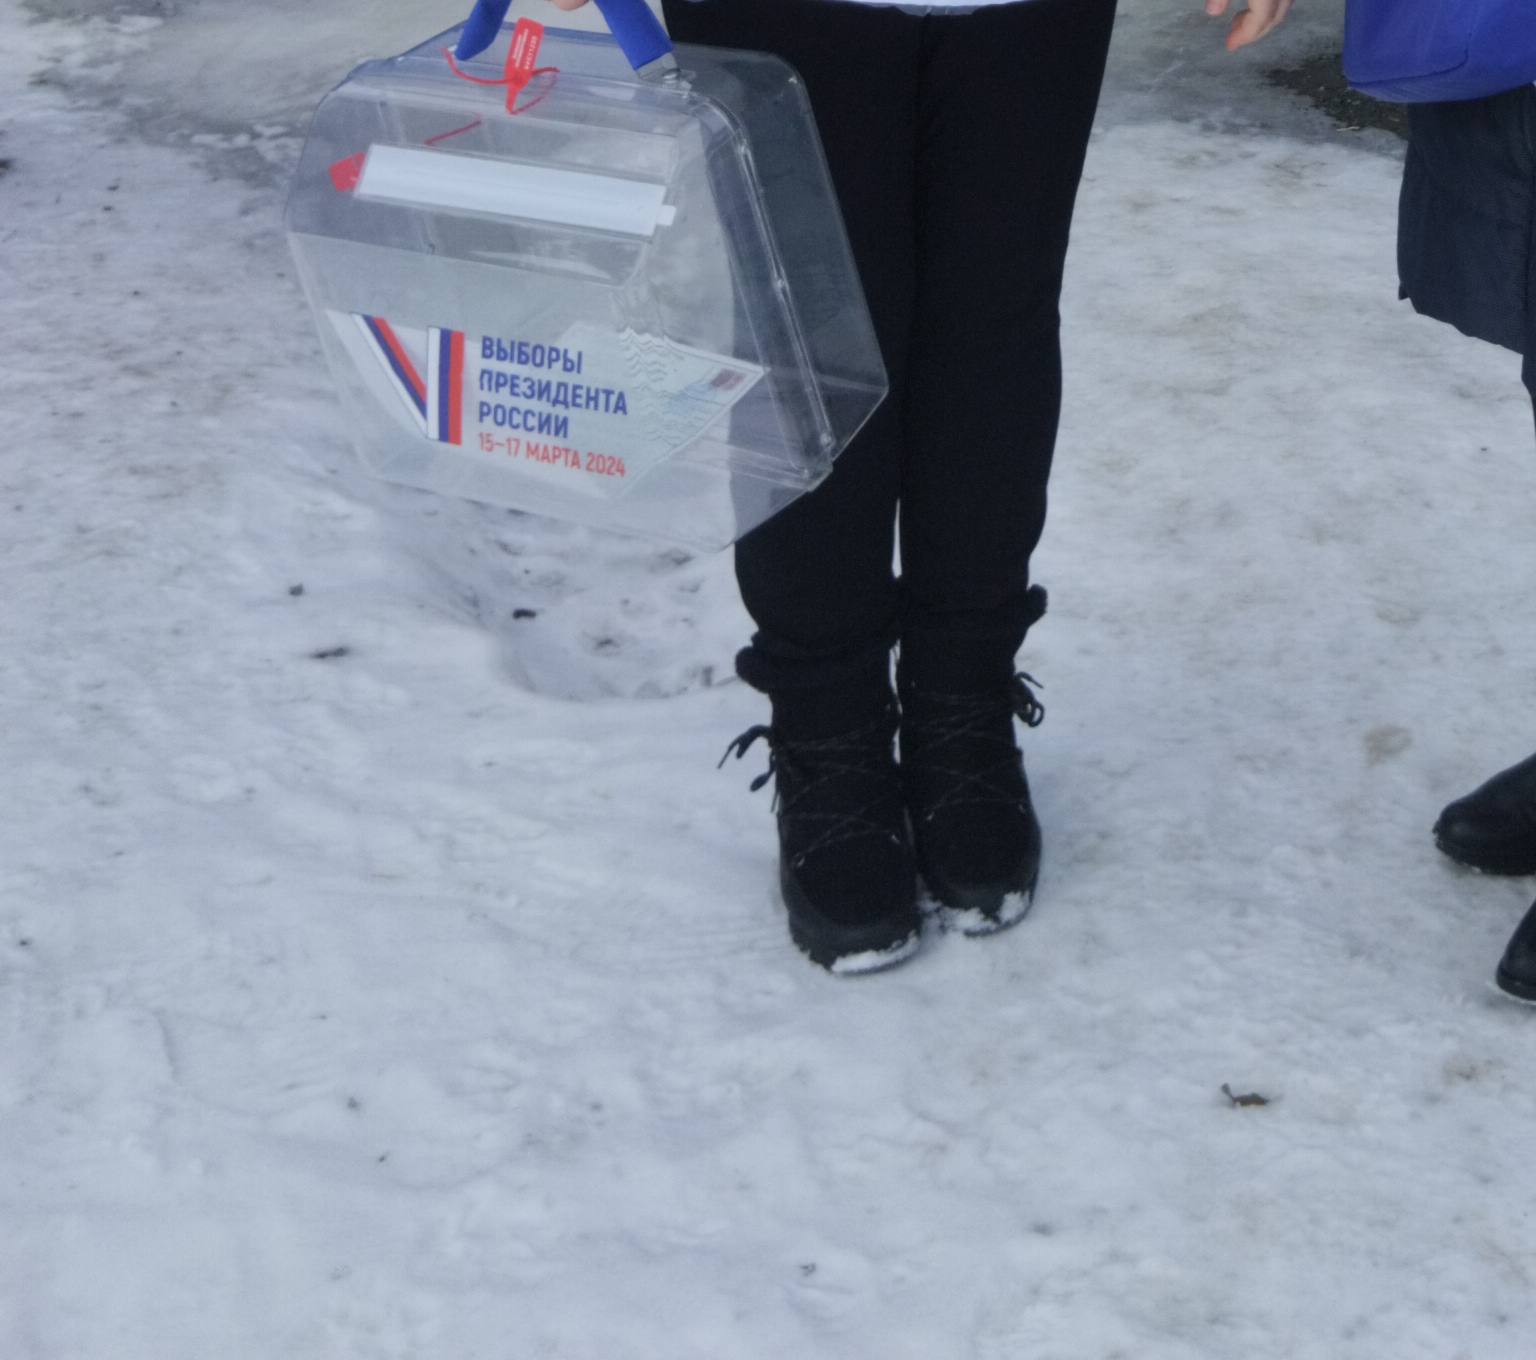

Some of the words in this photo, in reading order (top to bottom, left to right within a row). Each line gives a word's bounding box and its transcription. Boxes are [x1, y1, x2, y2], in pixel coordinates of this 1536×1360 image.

[481, 335, 583, 374] ВЫБОРЫ
[479, 368, 628, 416] ПРЕЗИДЕНТА
[478, 400, 569, 439] РОССИИ
[525, 441, 581, 469] МАРТА
[585, 451, 627, 477] 2024
